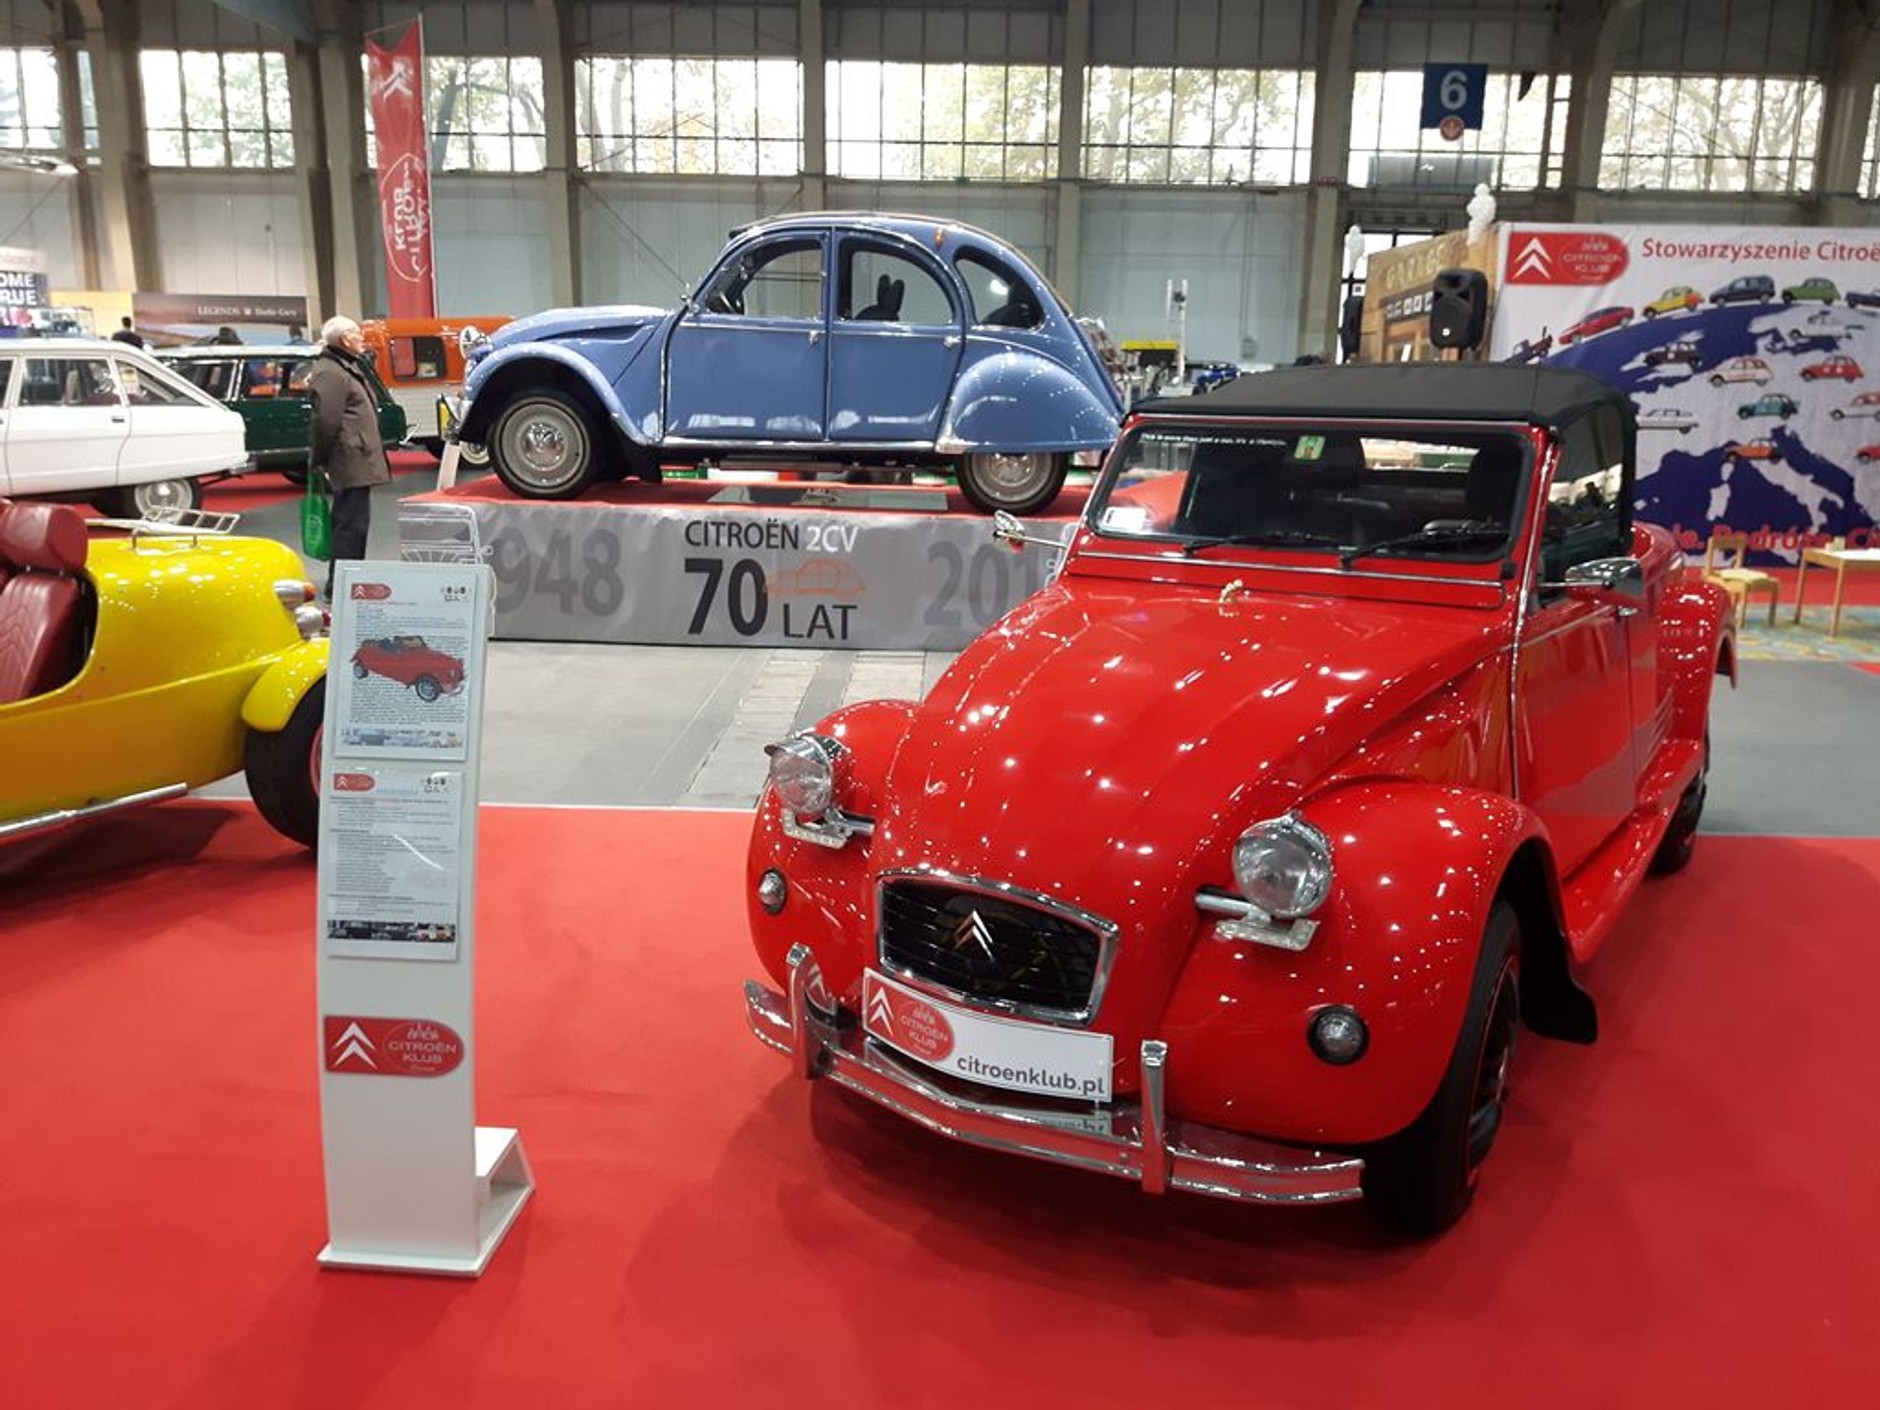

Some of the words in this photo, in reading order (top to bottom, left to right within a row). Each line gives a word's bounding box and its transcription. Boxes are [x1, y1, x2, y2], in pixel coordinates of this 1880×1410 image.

[1441, 70, 1468, 110] 6
[393, 187, 406, 250] KLUB
[1642, 238, 1810, 262] Stowarzyszenie
[685, 518, 799, 550] CITROËN
[806, 525, 859, 552] 2CV
[684, 558, 768, 637] 70
[783, 603, 858, 640] LAT
[402, 1053, 442, 1063] KLUB
[957, 1056, 1105, 1096] citroenklub.pl
